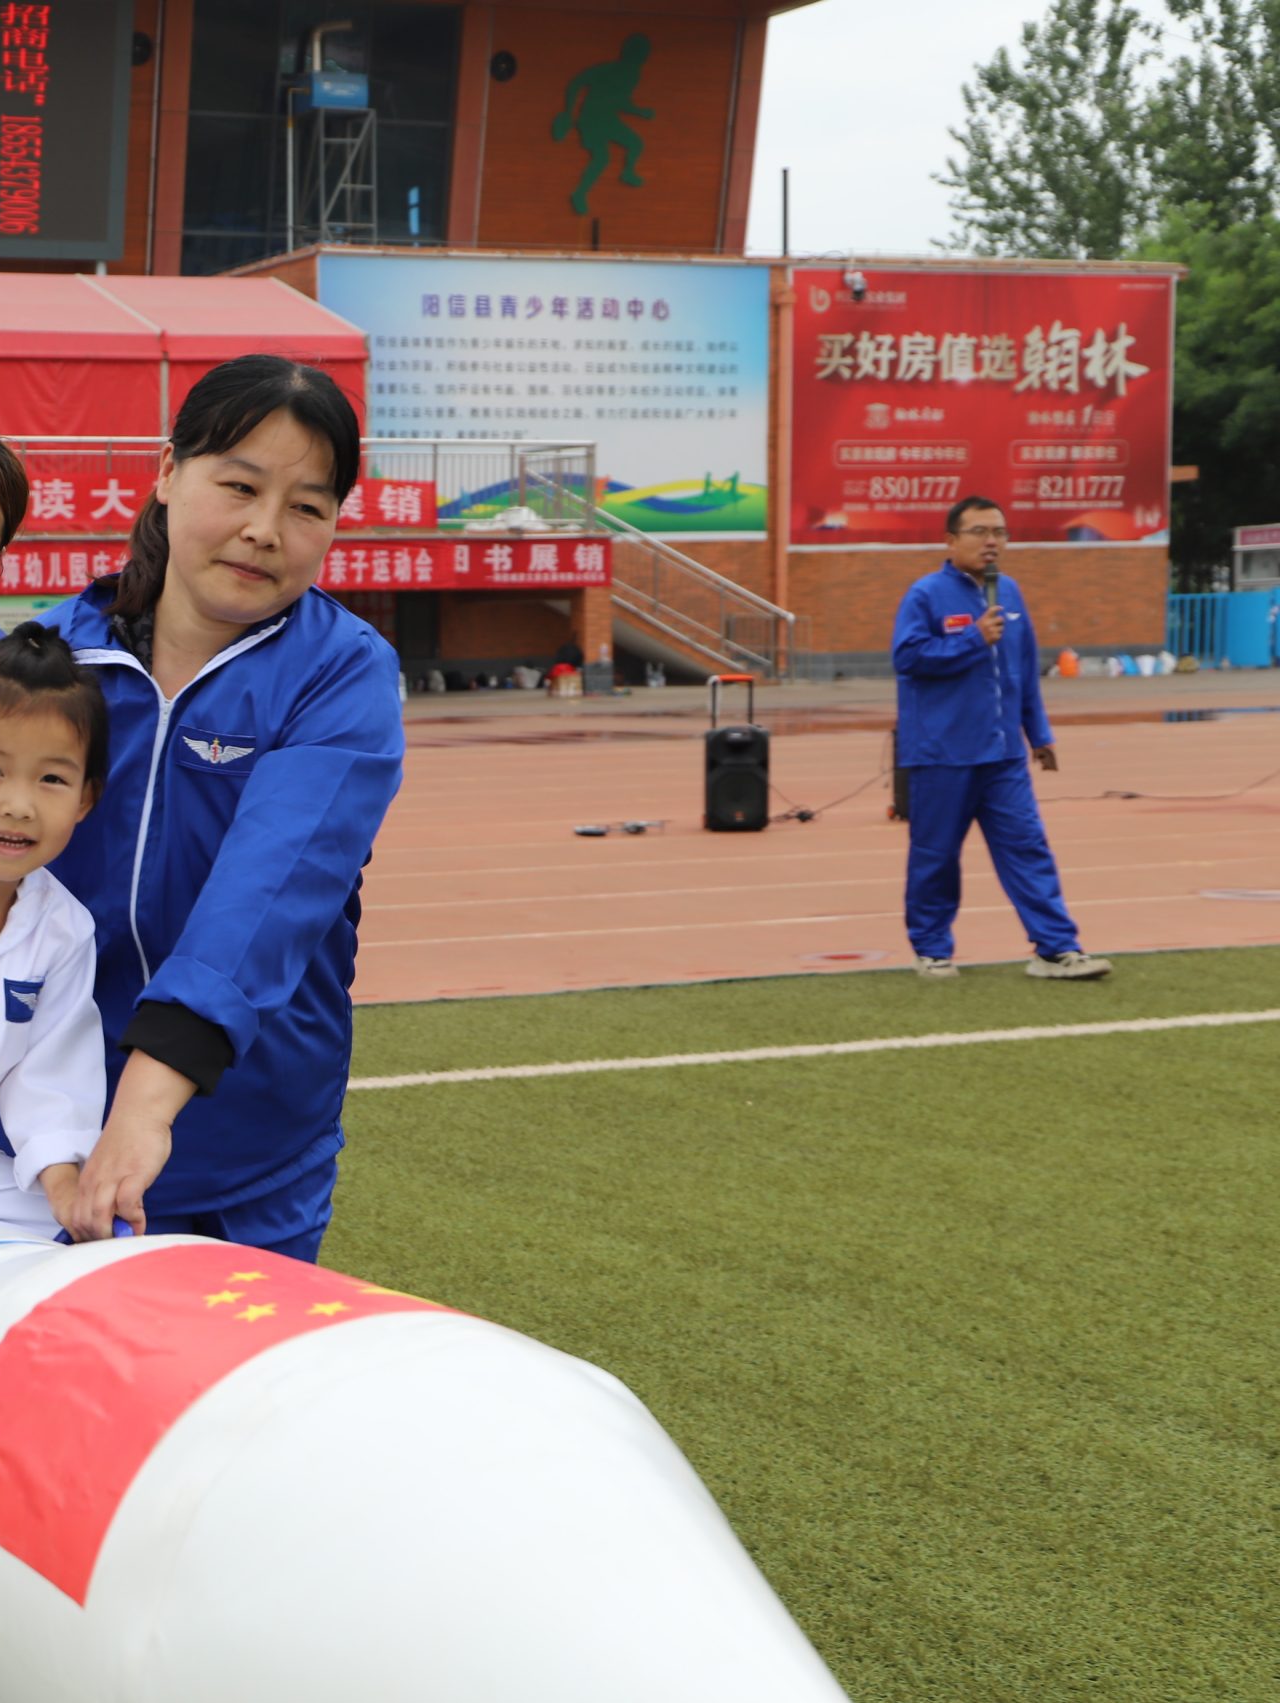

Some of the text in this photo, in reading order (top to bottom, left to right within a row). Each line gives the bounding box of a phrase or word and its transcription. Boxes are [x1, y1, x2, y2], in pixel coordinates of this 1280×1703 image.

[422, 294, 670, 321] 阳信县青少年活动中心
[869, 476, 961, 499] 8501777
[1038, 475, 1125, 499] 8211777
